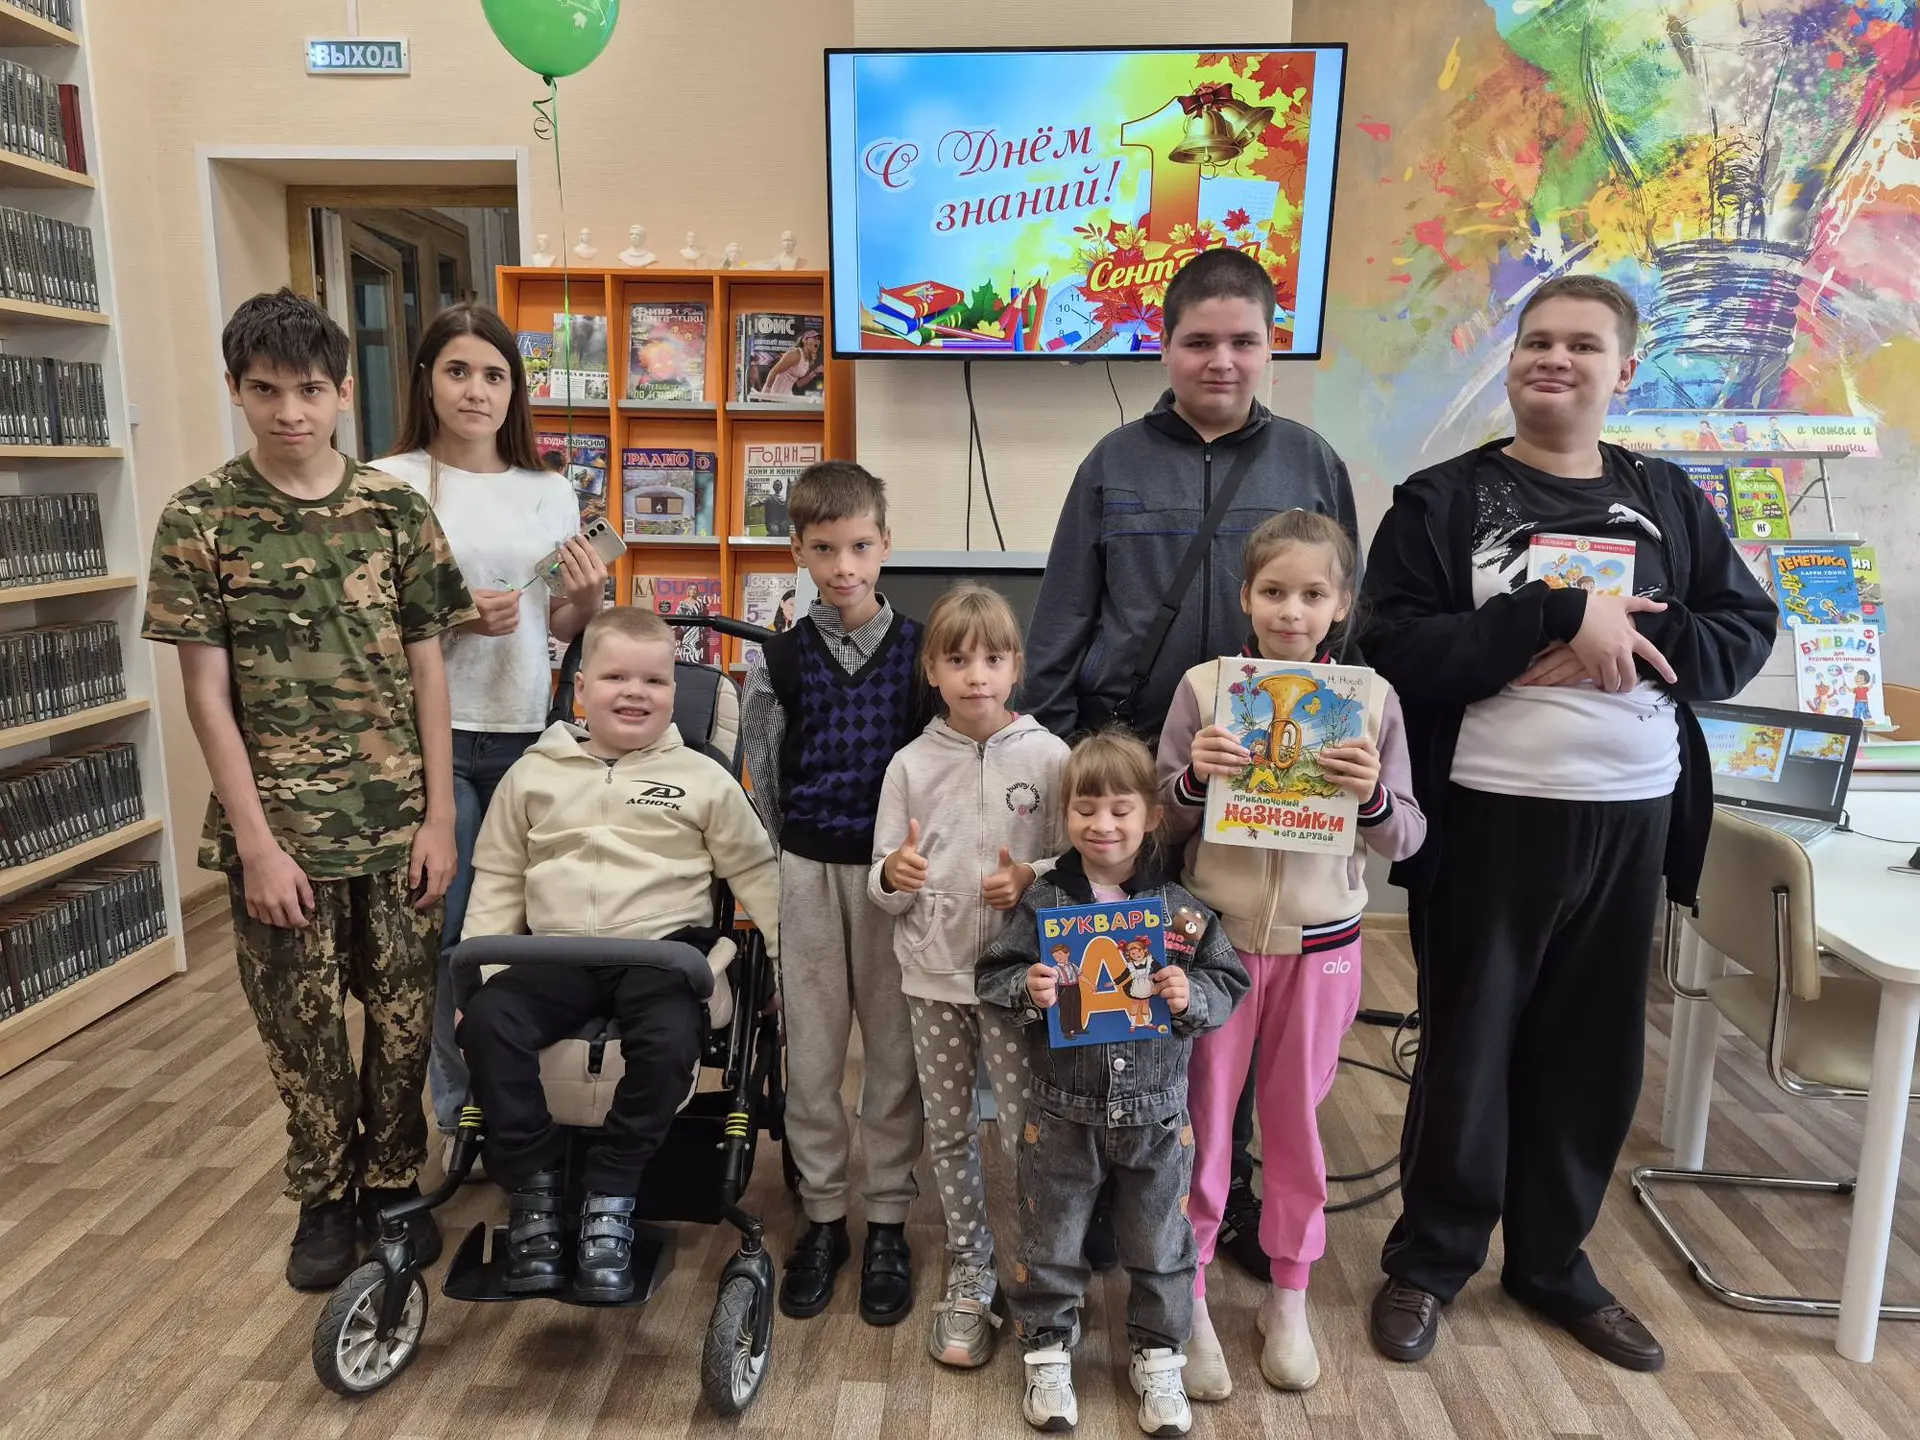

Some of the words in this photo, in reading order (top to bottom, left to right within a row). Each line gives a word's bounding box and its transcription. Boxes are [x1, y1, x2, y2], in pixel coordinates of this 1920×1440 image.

[315, 44, 398, 67] ВЫХОД
[866, 142, 918, 188] С
[937, 125, 1093, 177] Днём
[936, 160, 1121, 232] знаний!
[1070, 293, 1080, 302] 11
[1059, 304, 1071, 312] 10
[1055, 316, 1062, 325] 9
[544, 437, 564, 446] БУДЬ
[627, 453, 690, 468] РАДИО
[1777, 554, 1848, 572] ГЕНЕТИКА
[656, 578, 721, 596] buda
[1800, 635, 1876, 655] БУКВАРЬ
[1043, 909, 1161, 939] БУКВАРЬ
[1322, 955, 1351, 974] alo
[1078, 935, 1153, 1030] А
